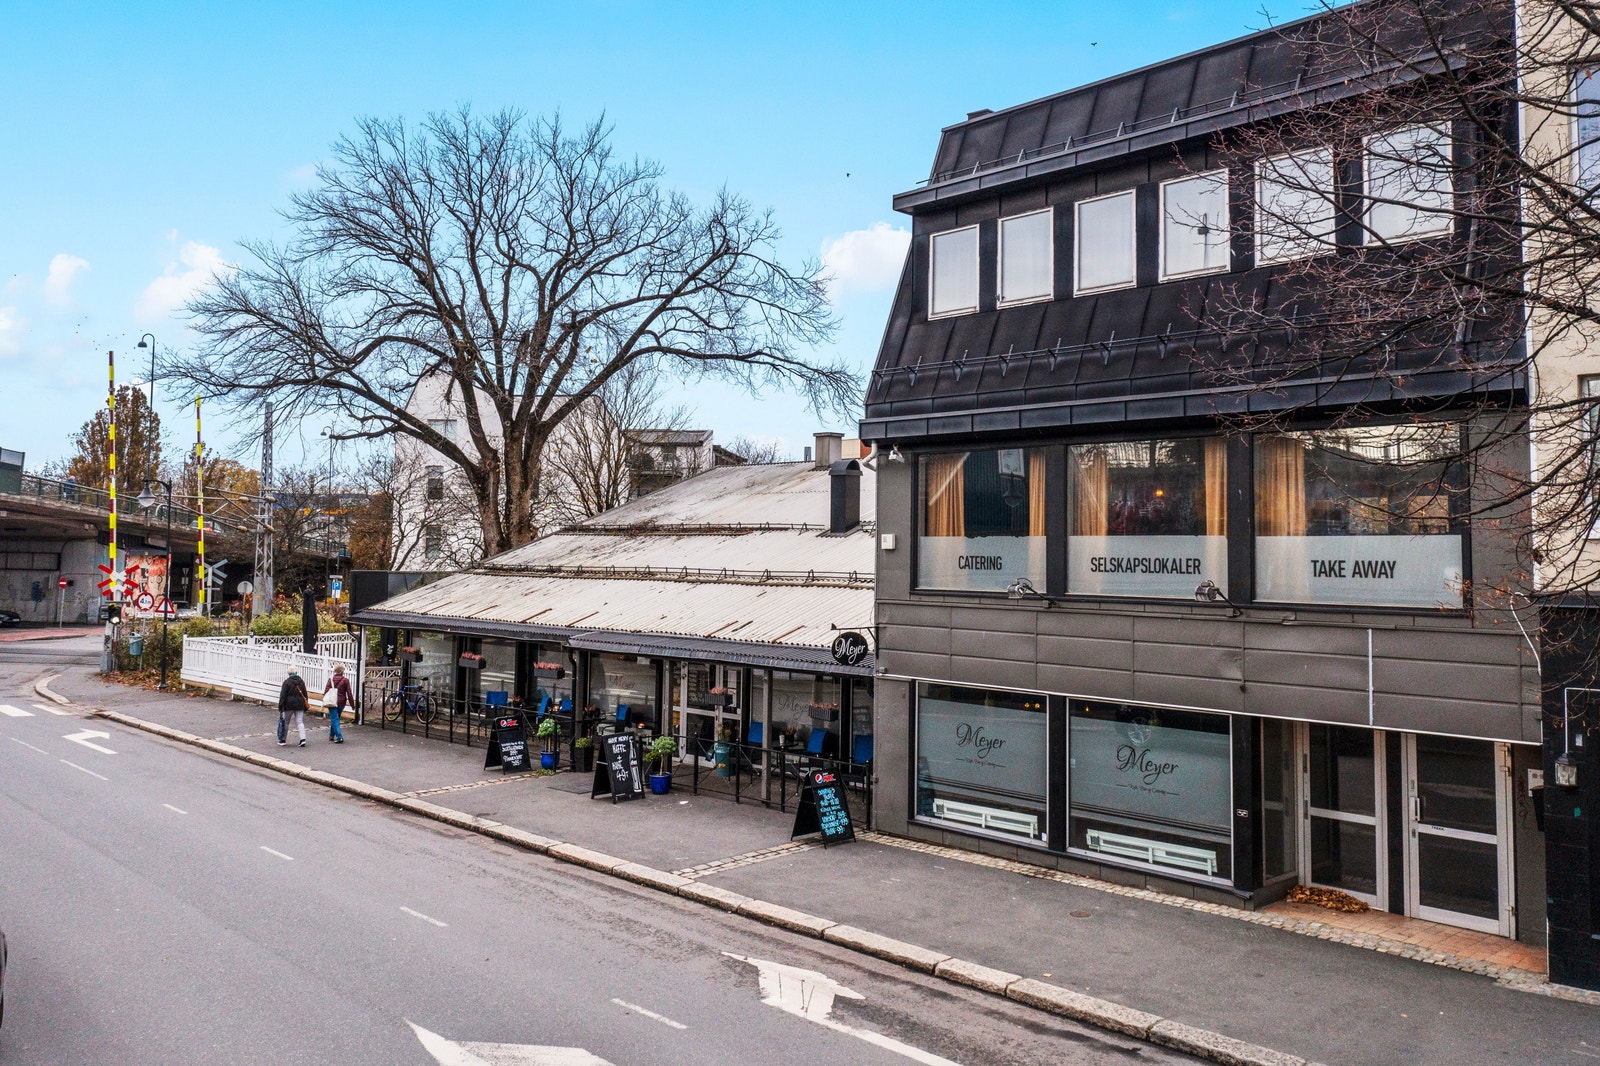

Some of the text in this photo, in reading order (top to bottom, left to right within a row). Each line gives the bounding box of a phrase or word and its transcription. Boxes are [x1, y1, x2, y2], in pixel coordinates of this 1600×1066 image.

[958, 555, 1003, 571] CATERING
[1090, 556, 1202, 575] SELSKAPSLOKALER
[1310, 559, 1397, 579] TAKE AWAY
[834, 637, 866, 664] Meyer
[955, 722, 1006, 759] Meyer
[1116, 744, 1179, 785] Meyer
